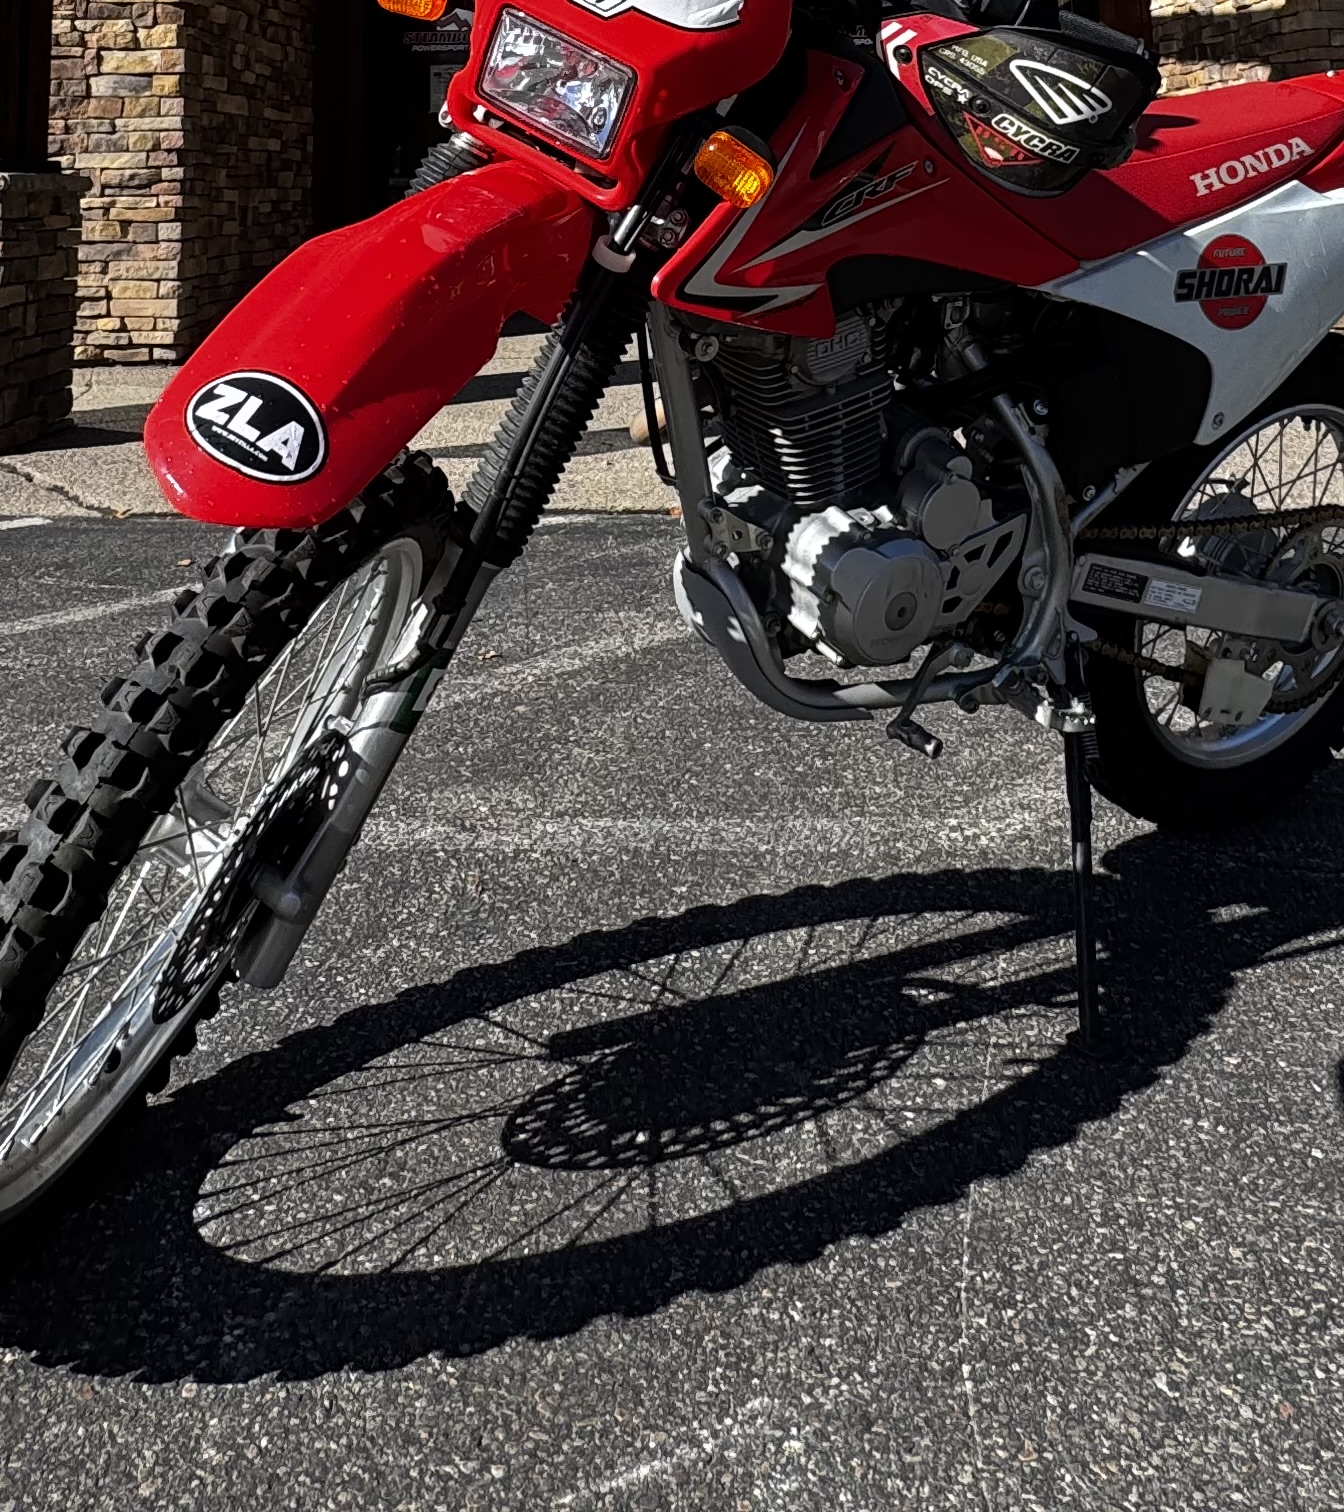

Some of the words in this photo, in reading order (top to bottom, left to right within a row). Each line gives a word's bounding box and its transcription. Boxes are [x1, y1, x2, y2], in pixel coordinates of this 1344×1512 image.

[925, 75, 953, 96] OPS
[927, 66, 970, 98] CYCRA
[992, 114, 1080, 164] CYCRA
[1189, 137, 1315, 197] HONDA
[821, 160, 919, 226] CRF
[1175, 265, 1286, 302] SHORAI
[195, 383, 305, 471] ZLA
